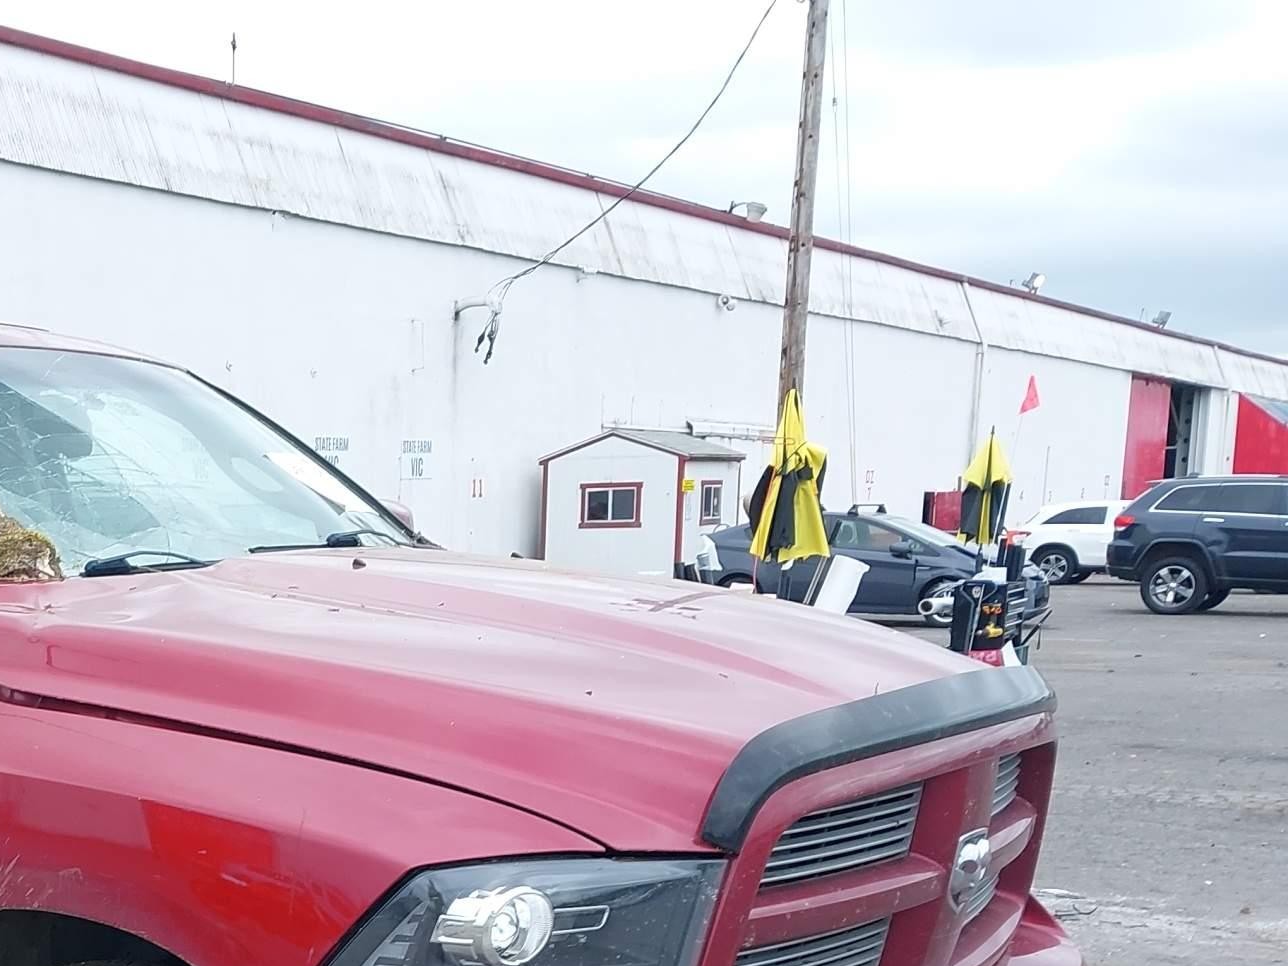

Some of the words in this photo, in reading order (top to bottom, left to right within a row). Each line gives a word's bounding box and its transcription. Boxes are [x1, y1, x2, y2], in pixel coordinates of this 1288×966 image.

[315, 437, 332, 451] STATE
[333, 438, 349, 451] FARM
[402, 440, 416, 454] STATE
[417, 441, 432, 453] FARM
[411, 458, 424, 477] VIC
[472, 479, 483, 498] 11
